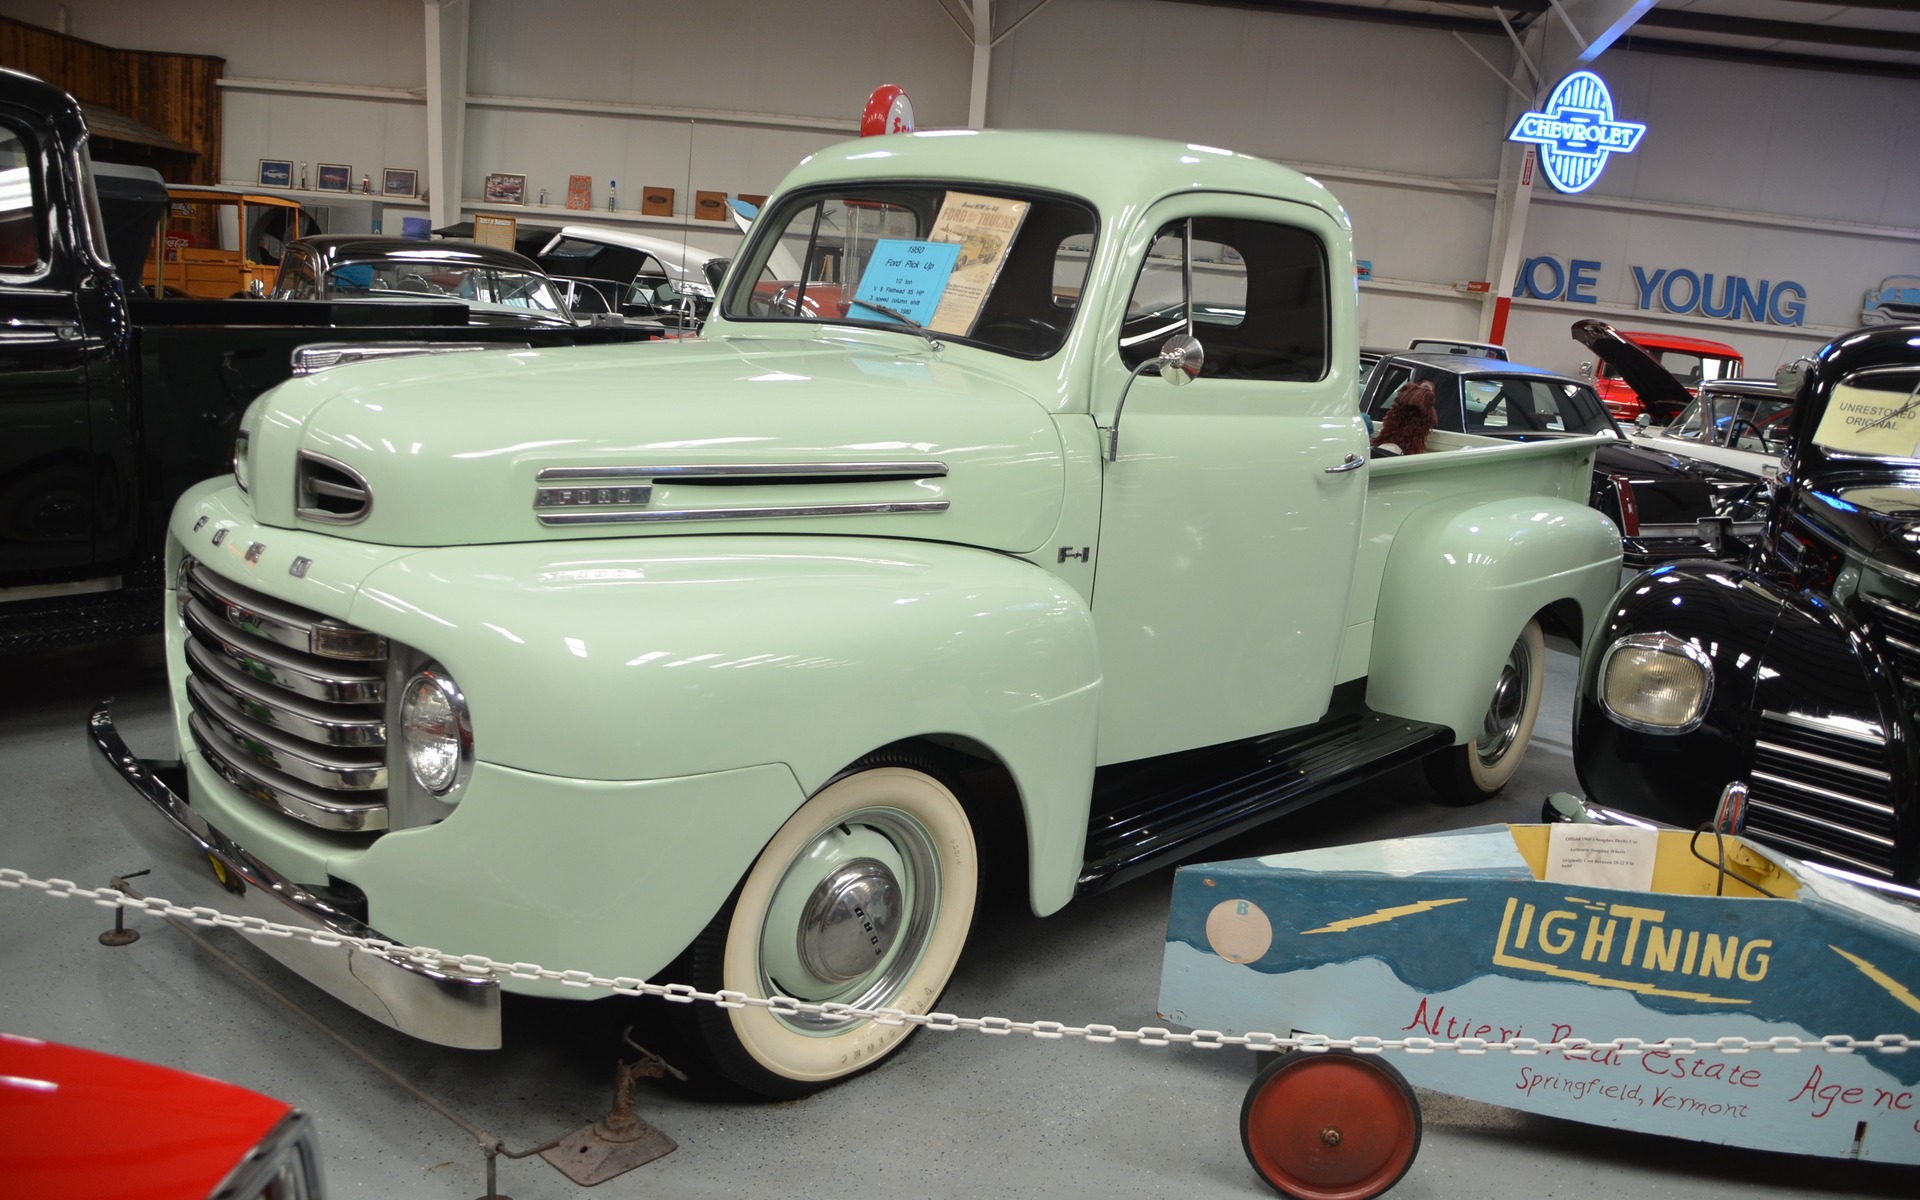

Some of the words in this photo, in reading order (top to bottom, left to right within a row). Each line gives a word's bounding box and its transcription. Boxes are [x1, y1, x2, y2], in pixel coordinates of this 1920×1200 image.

[1523, 119, 1633, 145] CHEVROLET
[942, 207, 968, 223] FORD
[977, 212, 1017, 230] TRUCKS
[885, 259, 902, 267] Ford
[905, 260, 919, 268] Pick
[924, 262, 935, 271] Up
[907, 245, 925, 254] 1950
[1633, 266, 1807, 327] YOUNG
[560, 489, 630, 504] FORD
[193, 515, 313, 578] FORD
[1236, 901, 1249, 916] B
[854, 907, 882, 955] FORD
[1493, 897, 1772, 985] LIGHTNING
[1401, 997, 1523, 1048] Altieri
[1642, 1040, 1762, 1088] Estate
[1789, 1064, 1920, 1133] Agenc
[1516, 1067, 1644, 1107] Springfield,
[1652, 1086, 1749, 1118] Vermont
